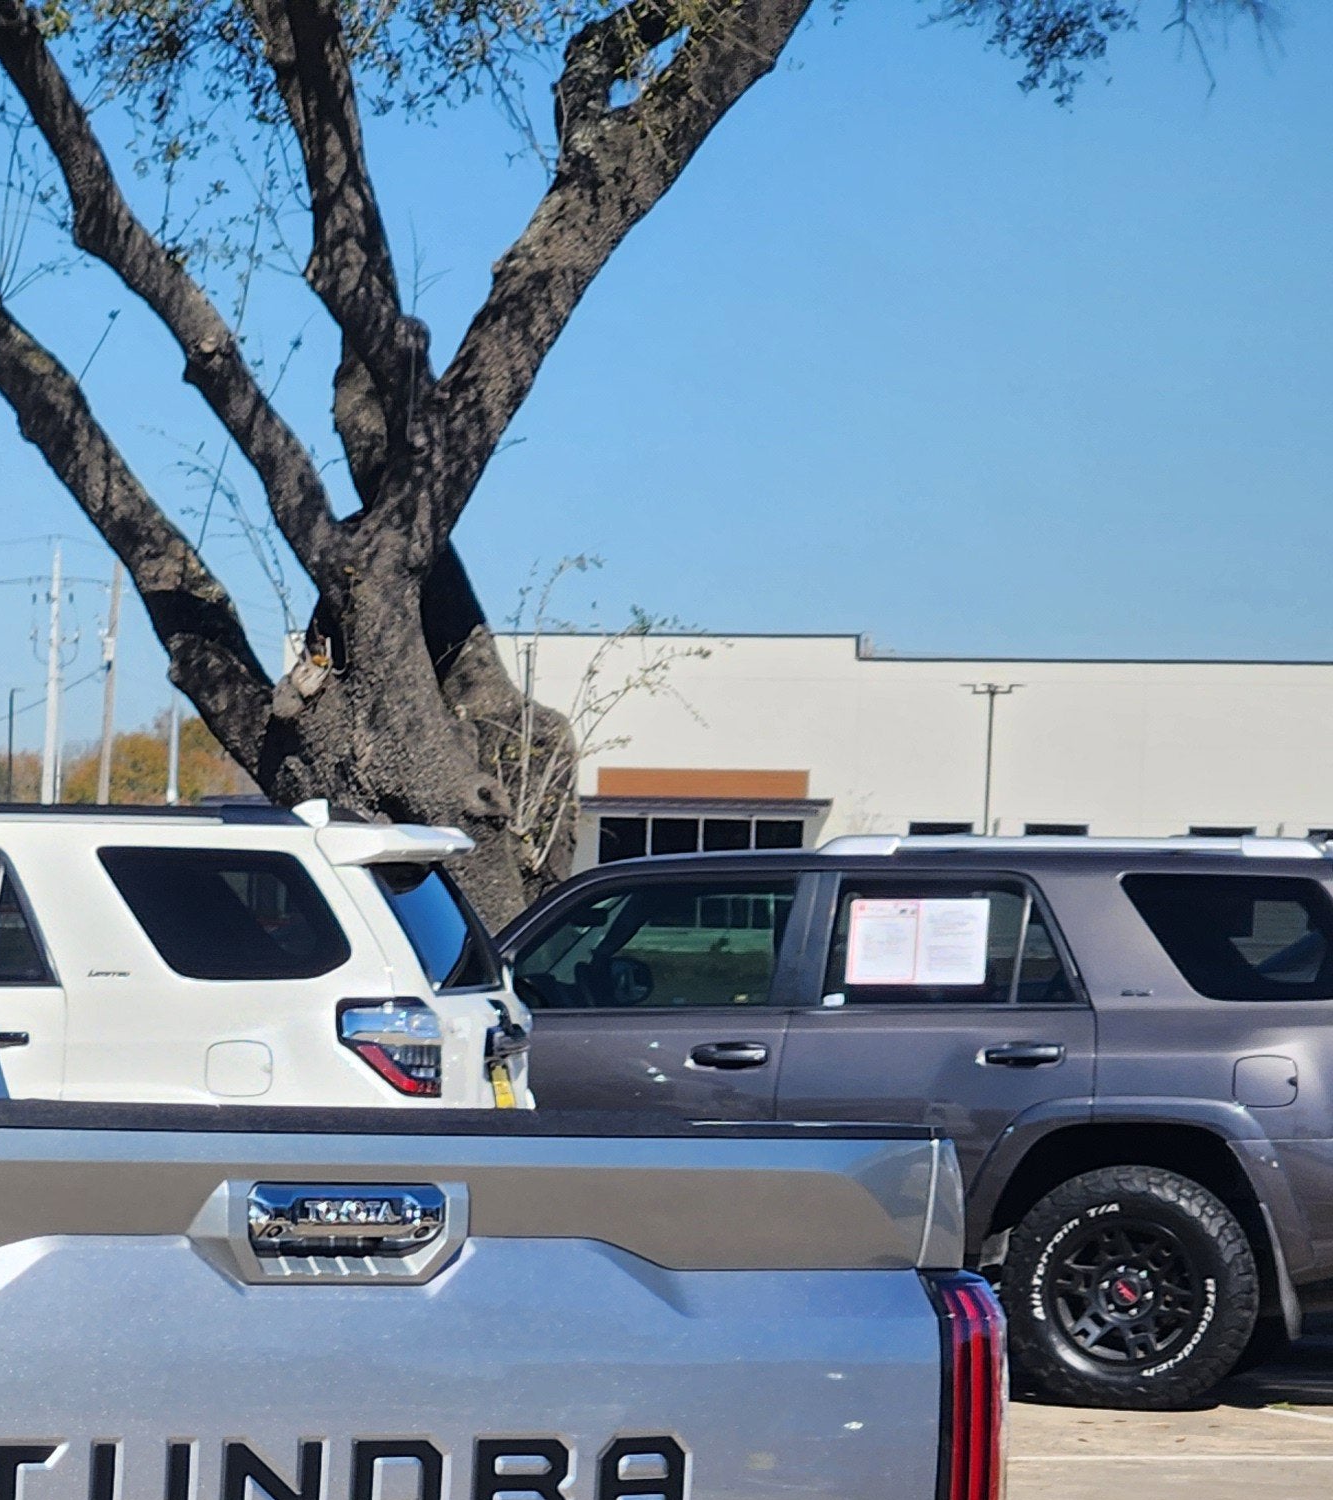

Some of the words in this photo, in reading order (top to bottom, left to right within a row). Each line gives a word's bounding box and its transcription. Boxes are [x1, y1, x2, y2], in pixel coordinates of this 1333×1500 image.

[304, 1200, 401, 1223] TOYOTA
[1086, 1203, 1120, 1218] T/A
[1140, 1277, 1217, 1377] BFGoodrich
